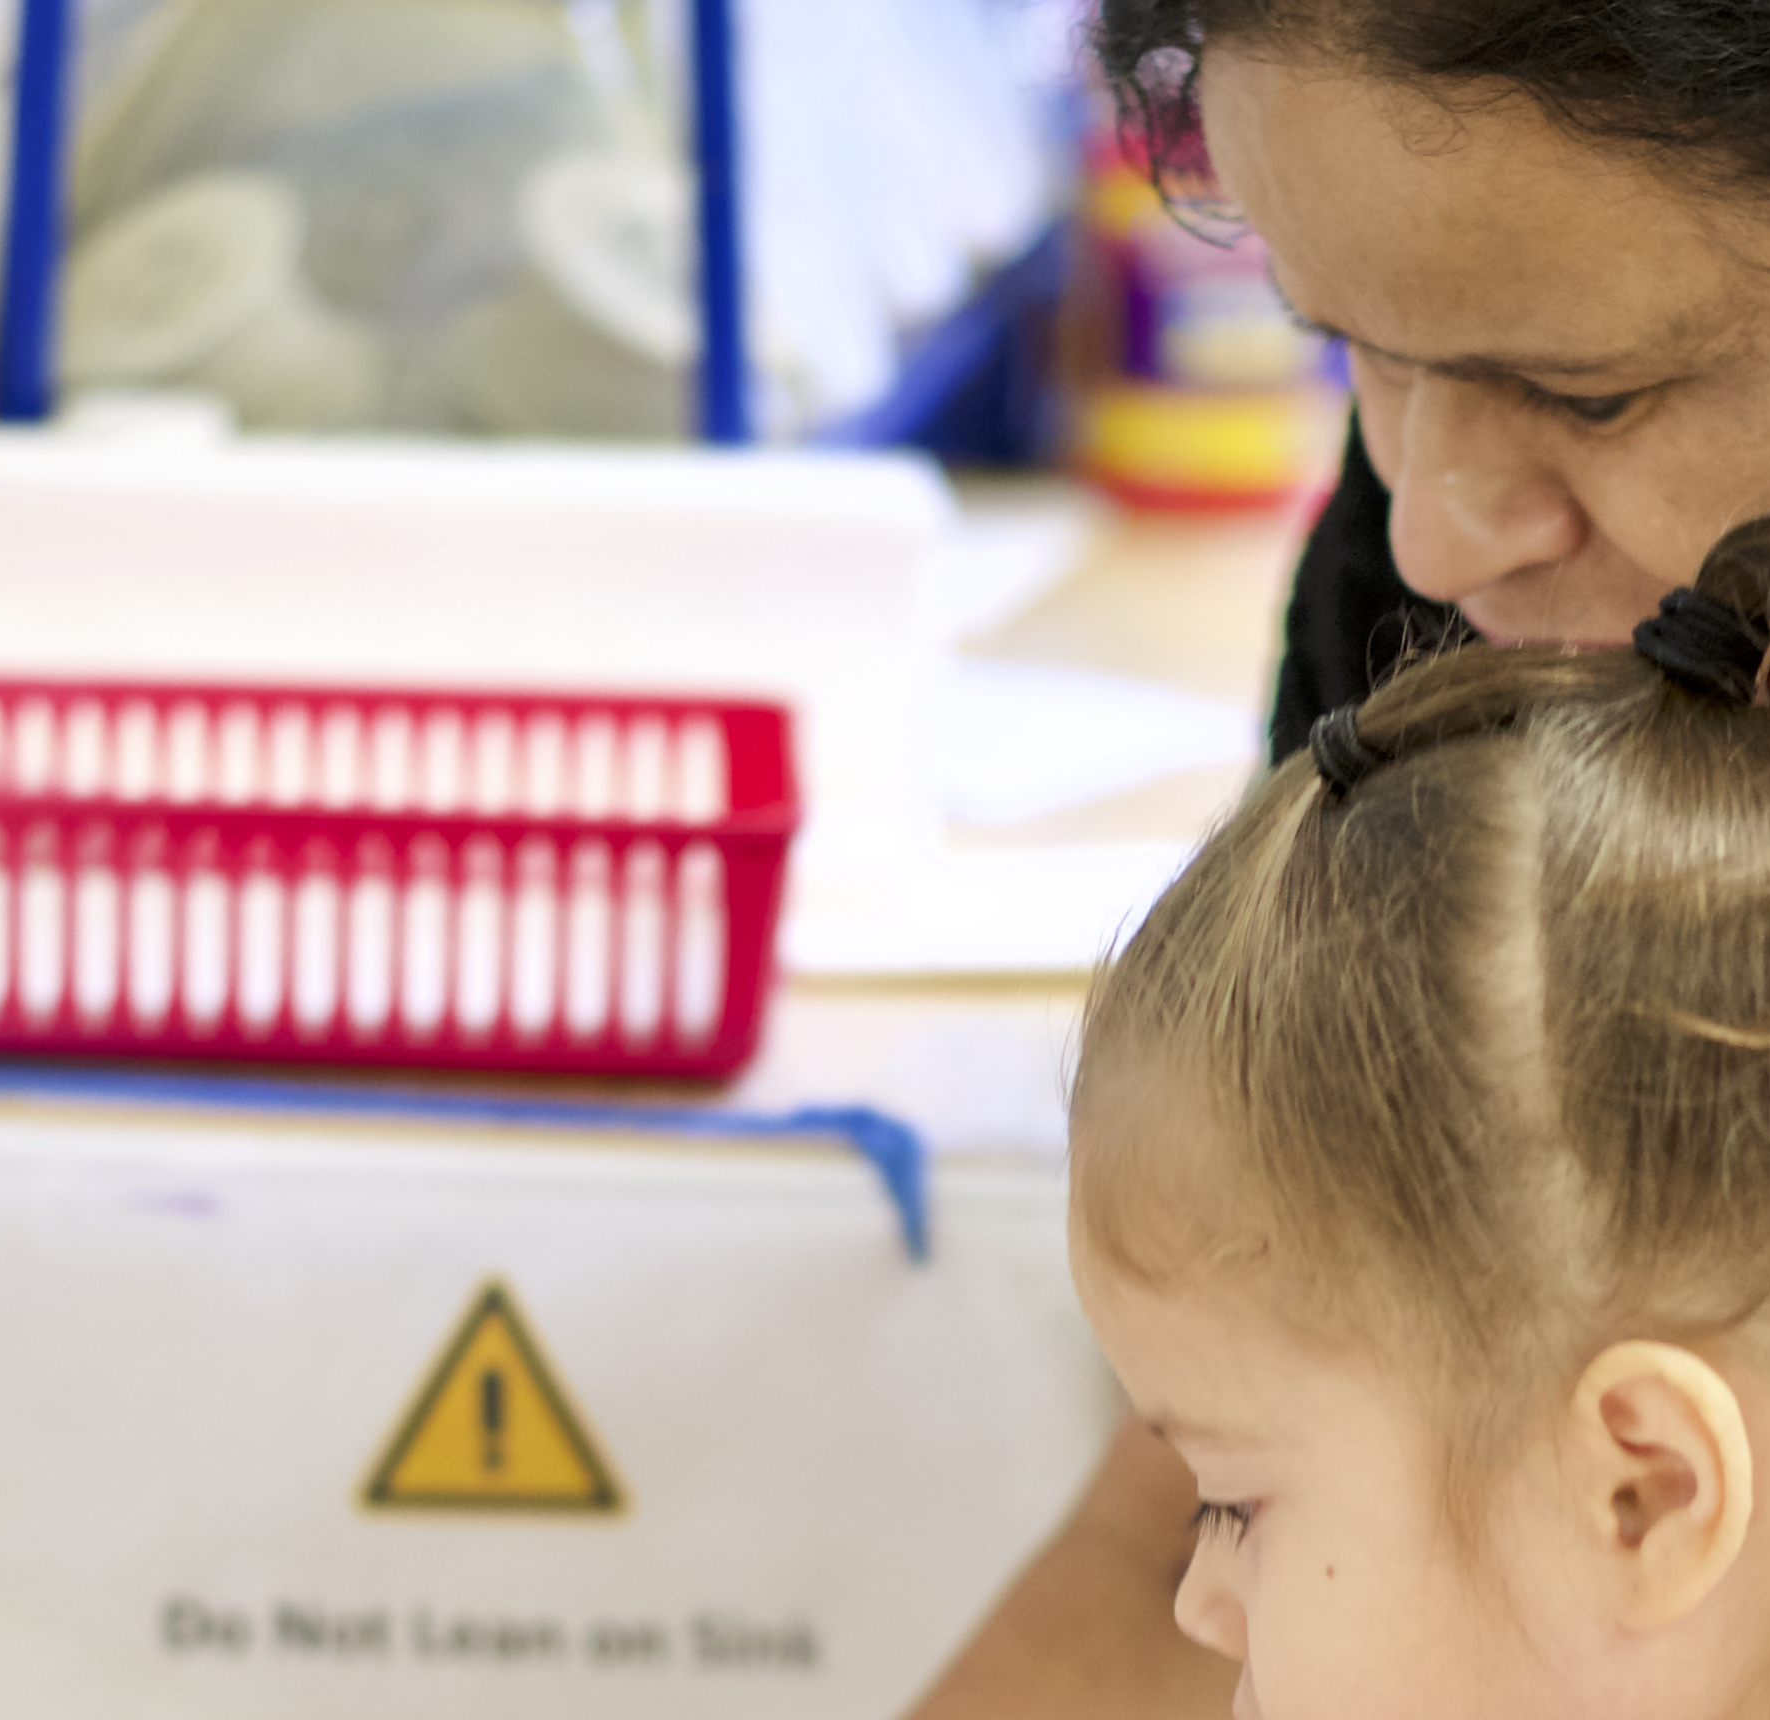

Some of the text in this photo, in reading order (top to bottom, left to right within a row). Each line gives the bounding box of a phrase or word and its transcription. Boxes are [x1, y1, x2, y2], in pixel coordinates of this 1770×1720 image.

[160, 1597, 822, 1672] Do Not Lean on Sink
